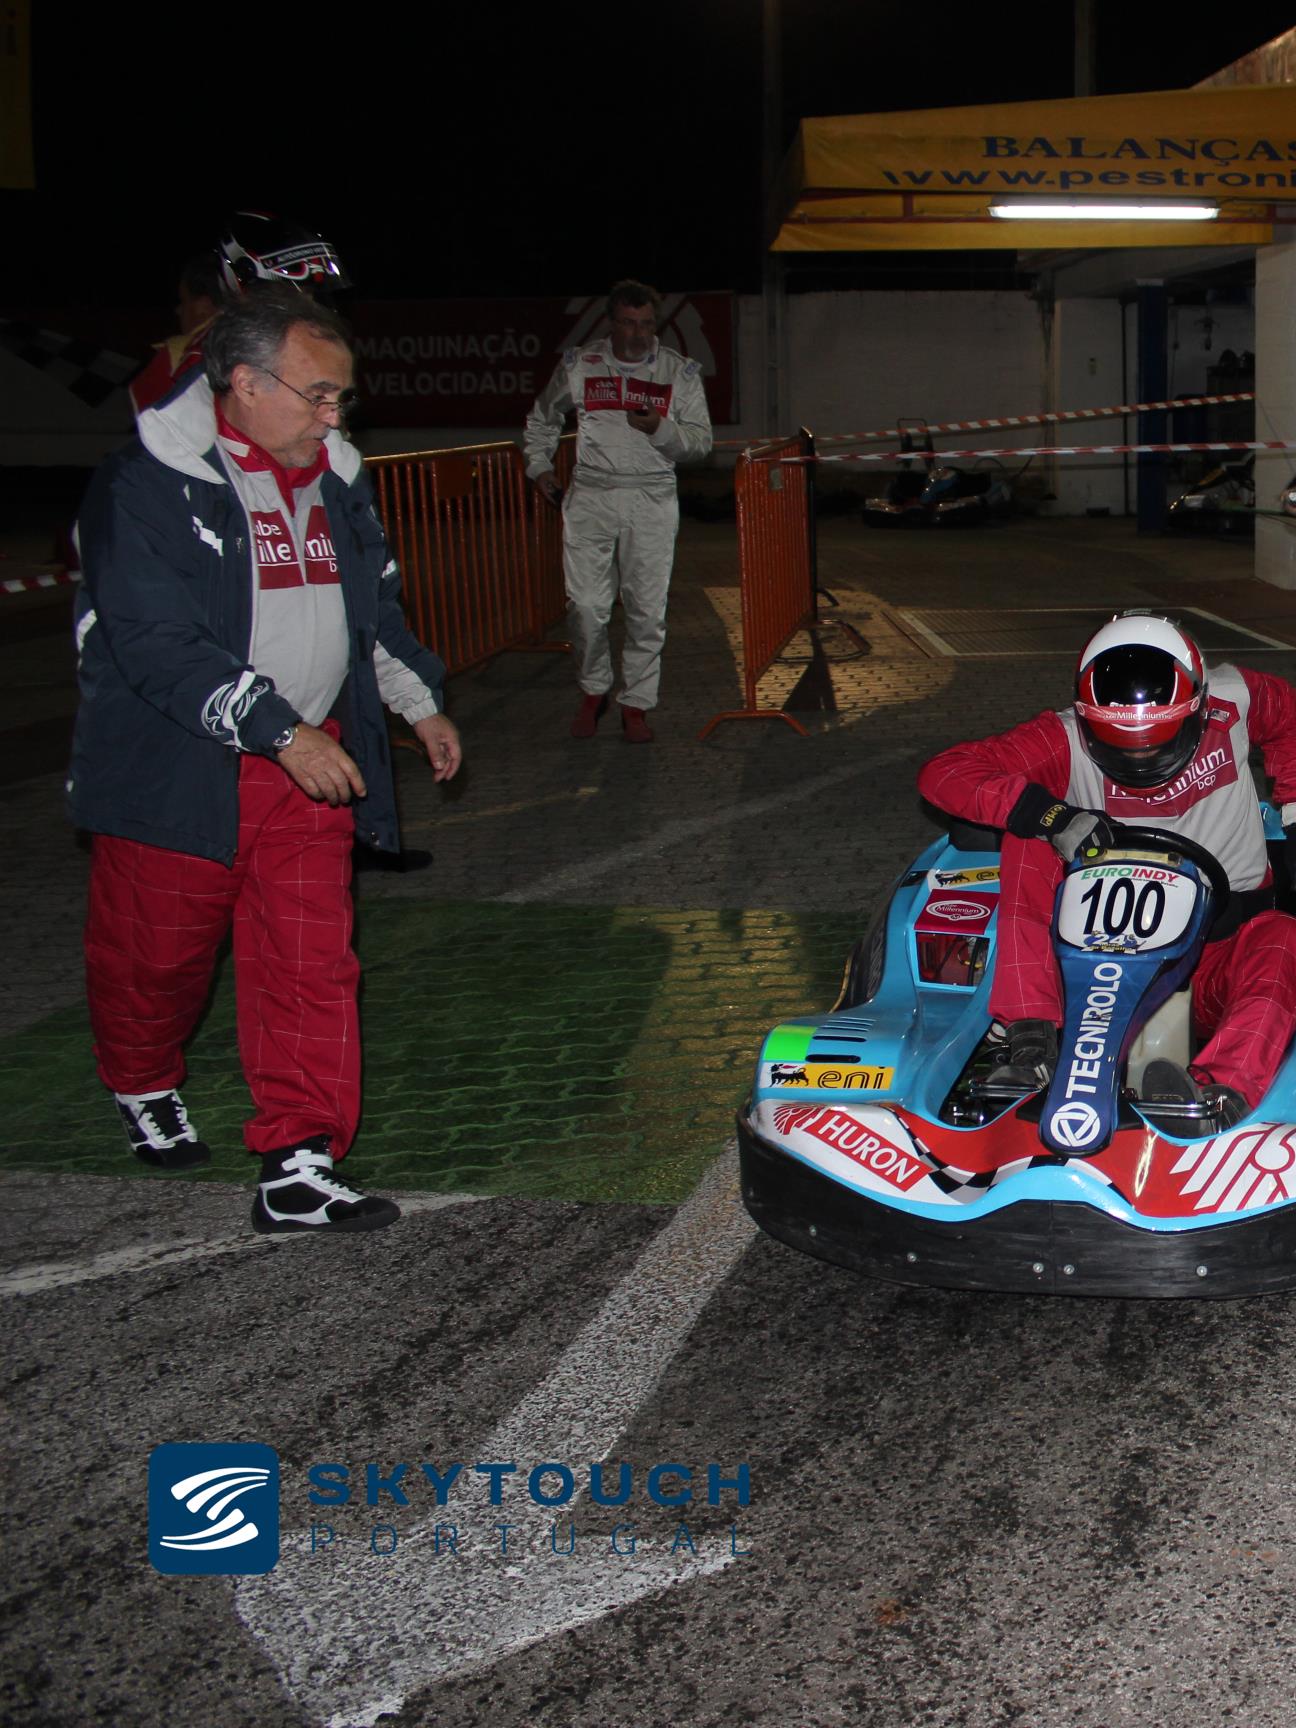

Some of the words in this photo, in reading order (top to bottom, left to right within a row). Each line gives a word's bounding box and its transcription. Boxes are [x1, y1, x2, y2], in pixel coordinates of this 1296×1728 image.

[354, 328, 541, 365] MAQUINAÇÃO
[363, 370, 536, 397] VELOCIDADE
[1196, 774, 1217, 791] bcp
[1080, 867, 1180, 883] EUROINDY
[1080, 877, 1166, 939] 100
[1064, 962, 1124, 1099] TECNIROLO
[817, 1066, 886, 1089] eni
[817, 1114, 920, 1184] HURON
